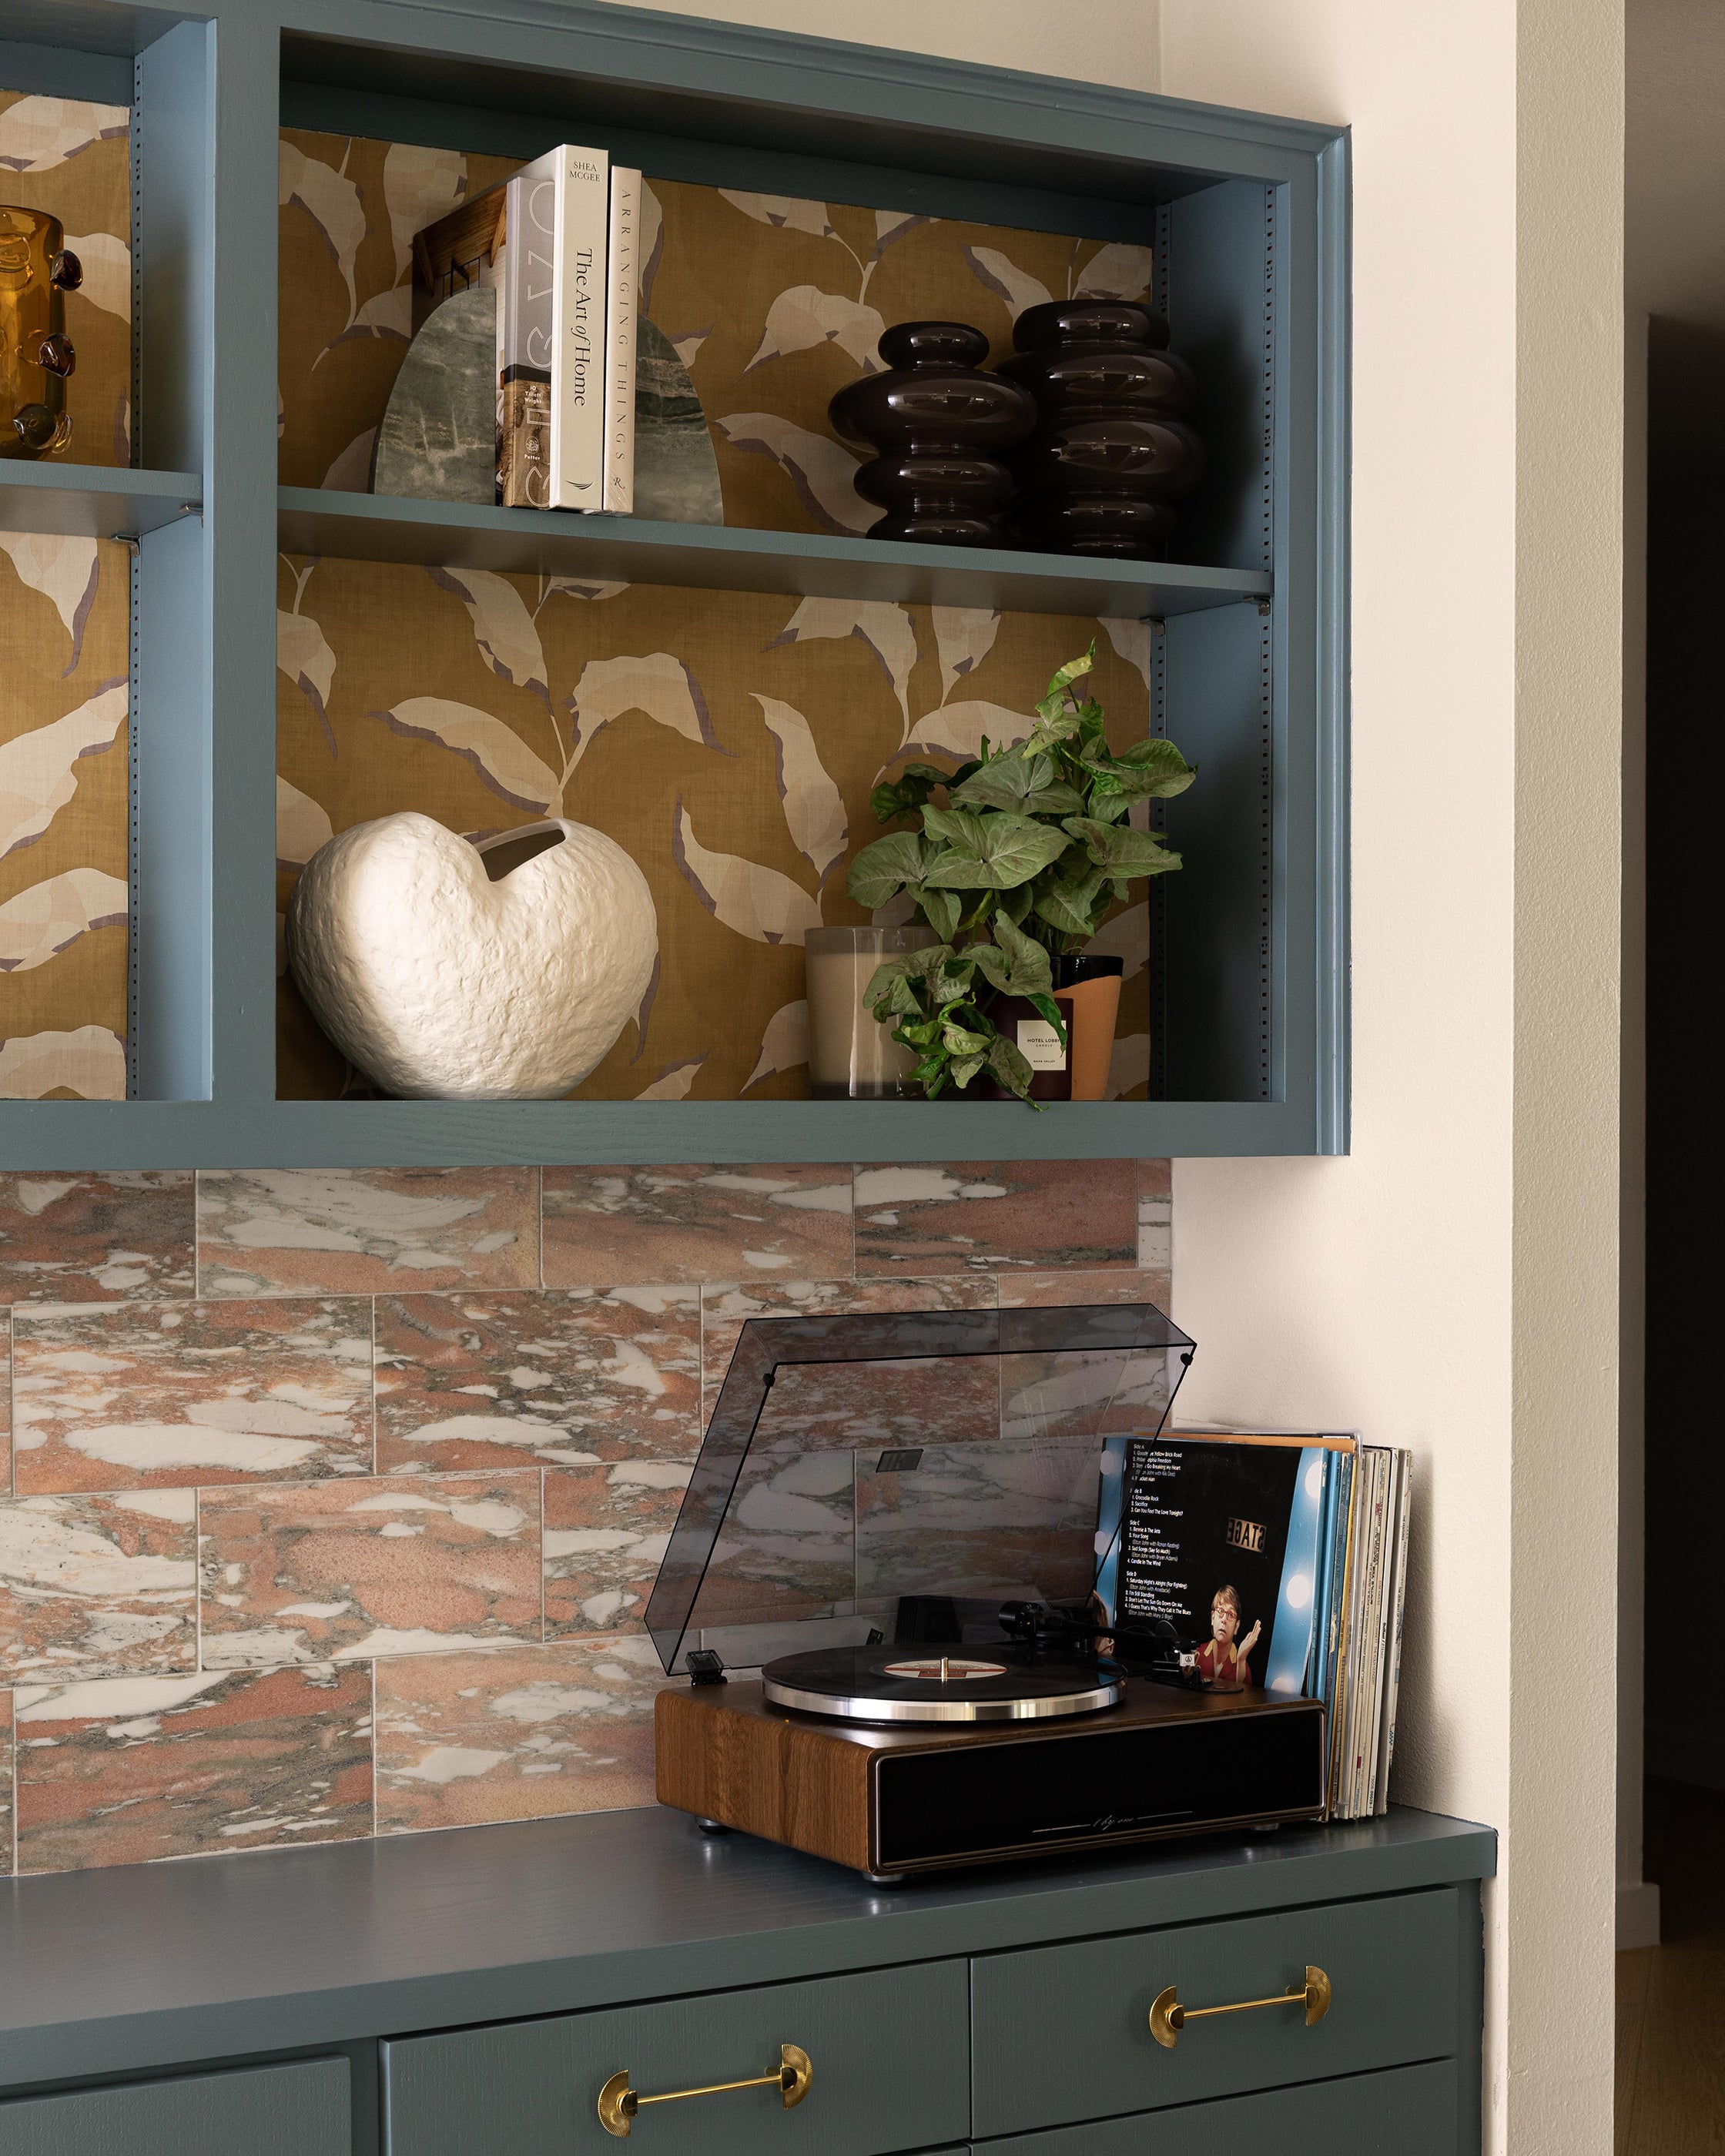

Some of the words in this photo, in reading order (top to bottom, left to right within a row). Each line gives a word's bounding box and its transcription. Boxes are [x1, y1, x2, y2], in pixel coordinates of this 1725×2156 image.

[569, 170, 601, 182] MCGEE
[573, 161, 597, 172] SHEA
[576, 248, 593, 286] The
[618, 189, 631, 346] ARRANGING
[576, 290, 591, 321] Art
[571, 325, 591, 345] of
[574, 346, 591, 407] Home
[616, 362, 627, 460] THINGS
